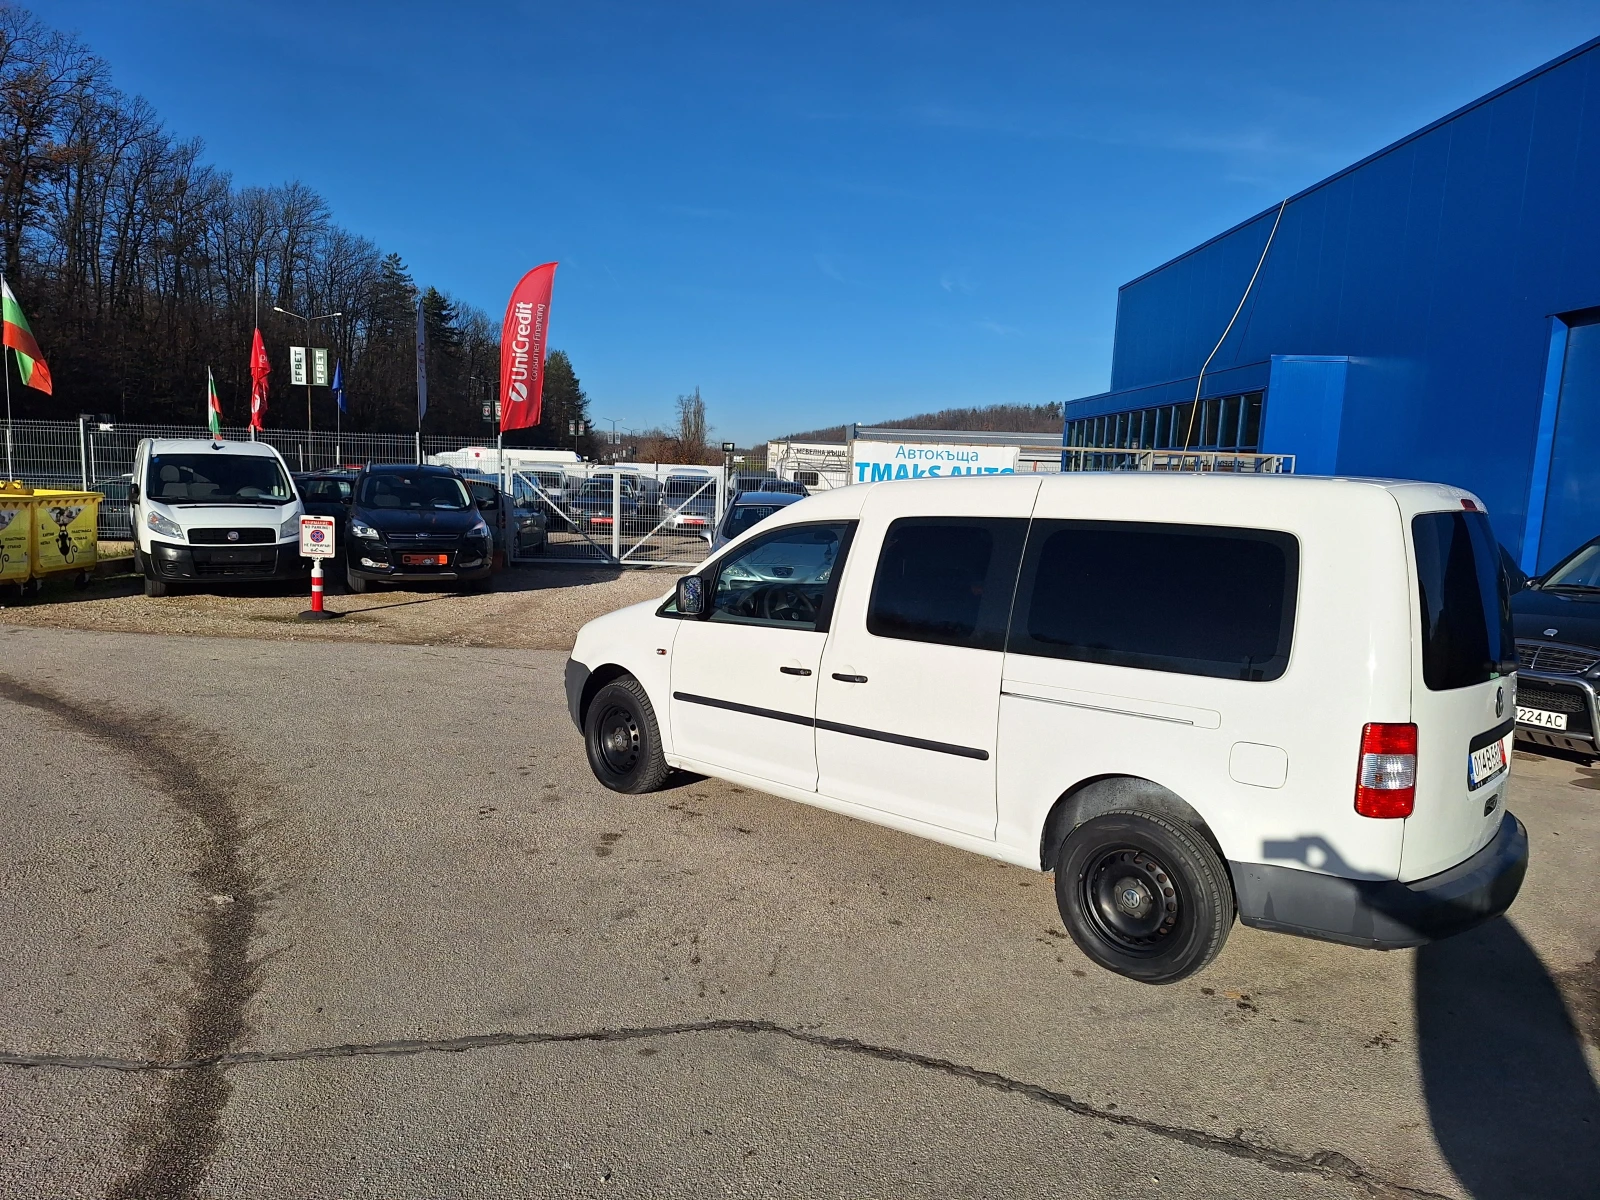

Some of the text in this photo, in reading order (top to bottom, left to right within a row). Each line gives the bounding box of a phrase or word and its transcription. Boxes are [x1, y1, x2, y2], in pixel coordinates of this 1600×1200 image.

[511, 301, 533, 380] UniCredit
[531, 303, 546, 381] Consumer Financing
[295, 350, 303, 382] EFBET
[315, 350, 325, 384] EFBET
[895, 445, 979, 464] Автокъща
[951, 465, 1014, 477] AU
[1516, 707, 1563, 728] 224 AC
